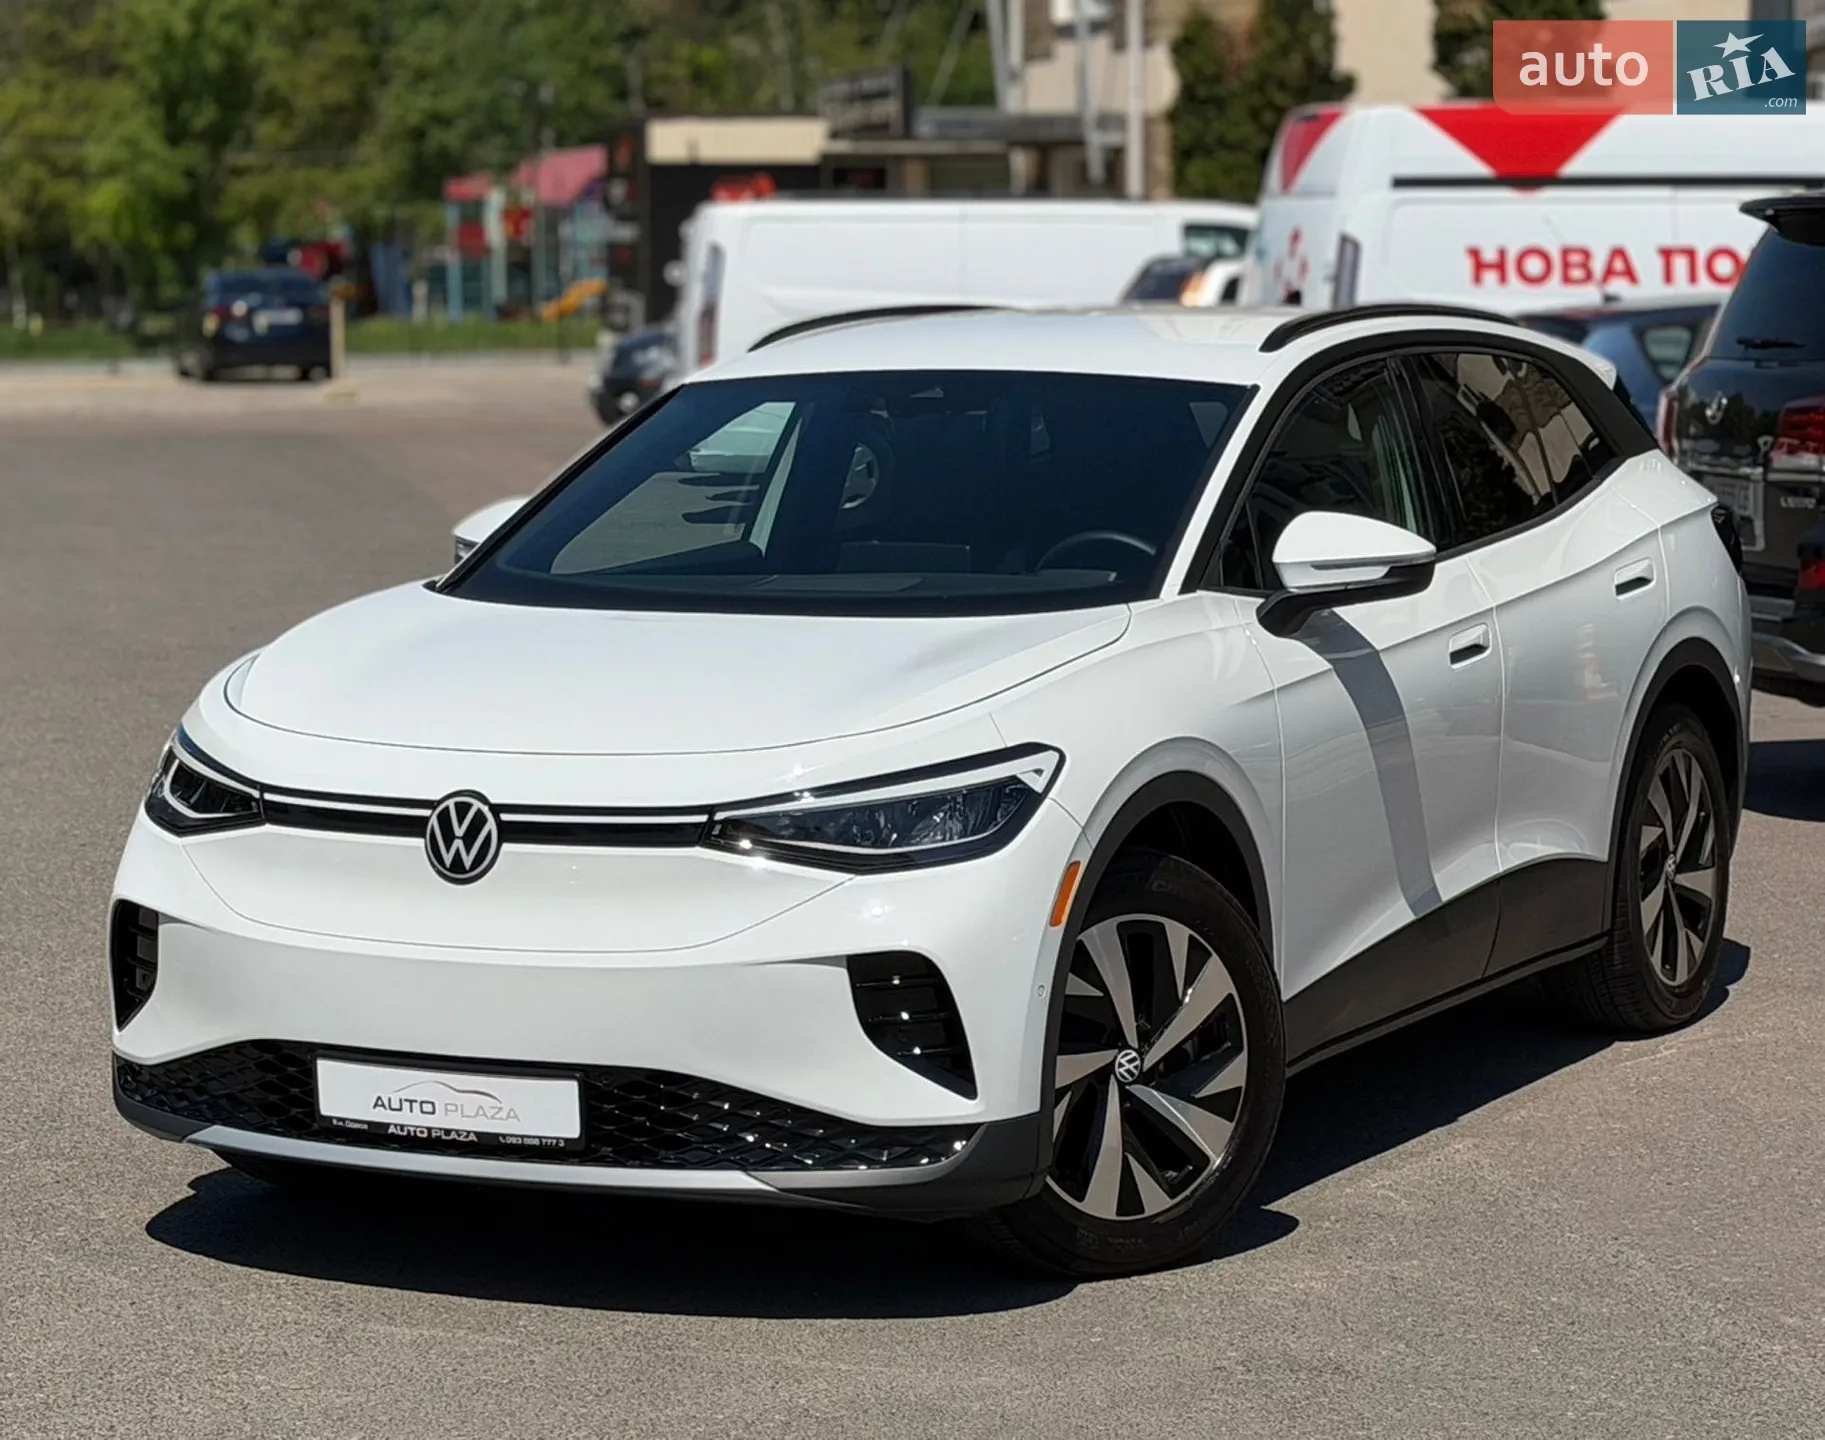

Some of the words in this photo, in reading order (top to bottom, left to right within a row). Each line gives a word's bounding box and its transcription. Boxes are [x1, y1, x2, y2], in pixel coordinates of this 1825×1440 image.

[1465, 245, 1639, 286] НОВА
[1656, 245, 1746, 286] ПО
[372, 1095, 436, 1116] AUTO
[444, 1102, 521, 1123] PLAZA
[388, 1124, 428, 1138] AUTO
[431, 1129, 478, 1143] PLAZA
